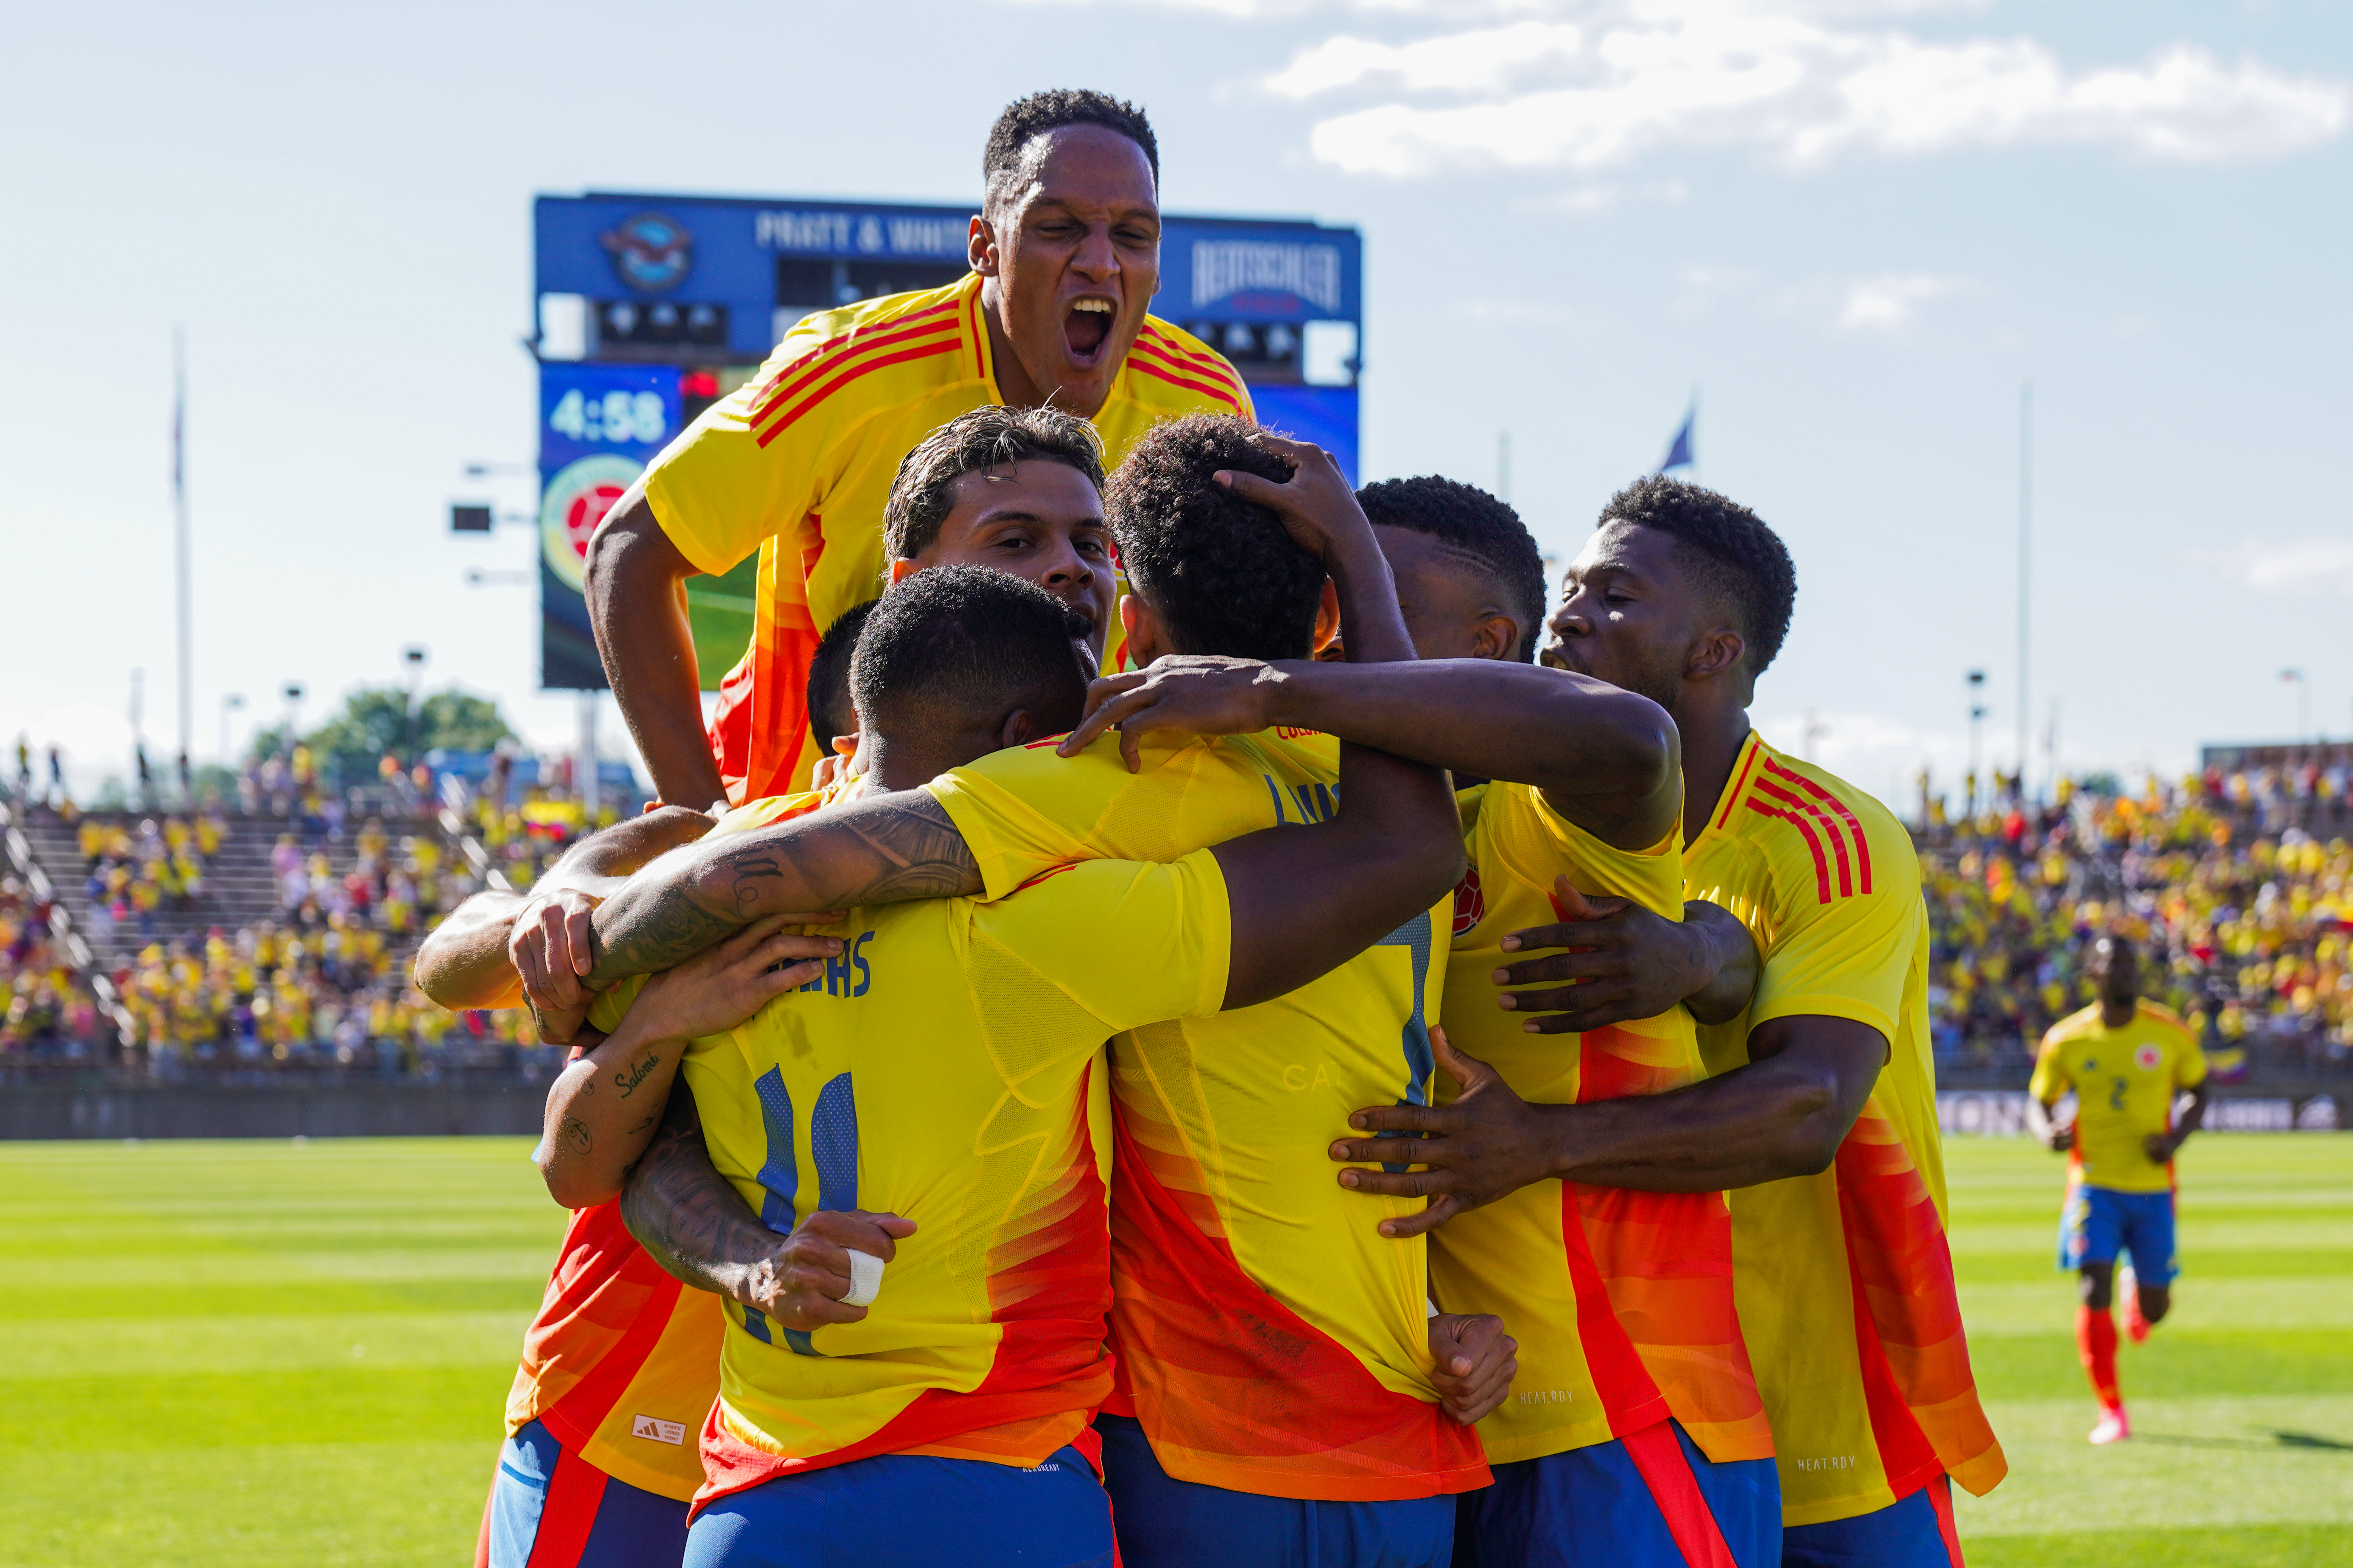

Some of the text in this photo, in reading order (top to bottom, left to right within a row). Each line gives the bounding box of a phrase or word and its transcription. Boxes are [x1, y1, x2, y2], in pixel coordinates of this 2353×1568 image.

[550, 388, 667, 444] 4:58
[2110, 1075, 2128, 1111] 2
[742, 1062, 858, 1357] 11
[1520, 1390, 1572, 1404] HEAT.RDY
[1798, 1456, 1854, 1471] HEAT.RDY
